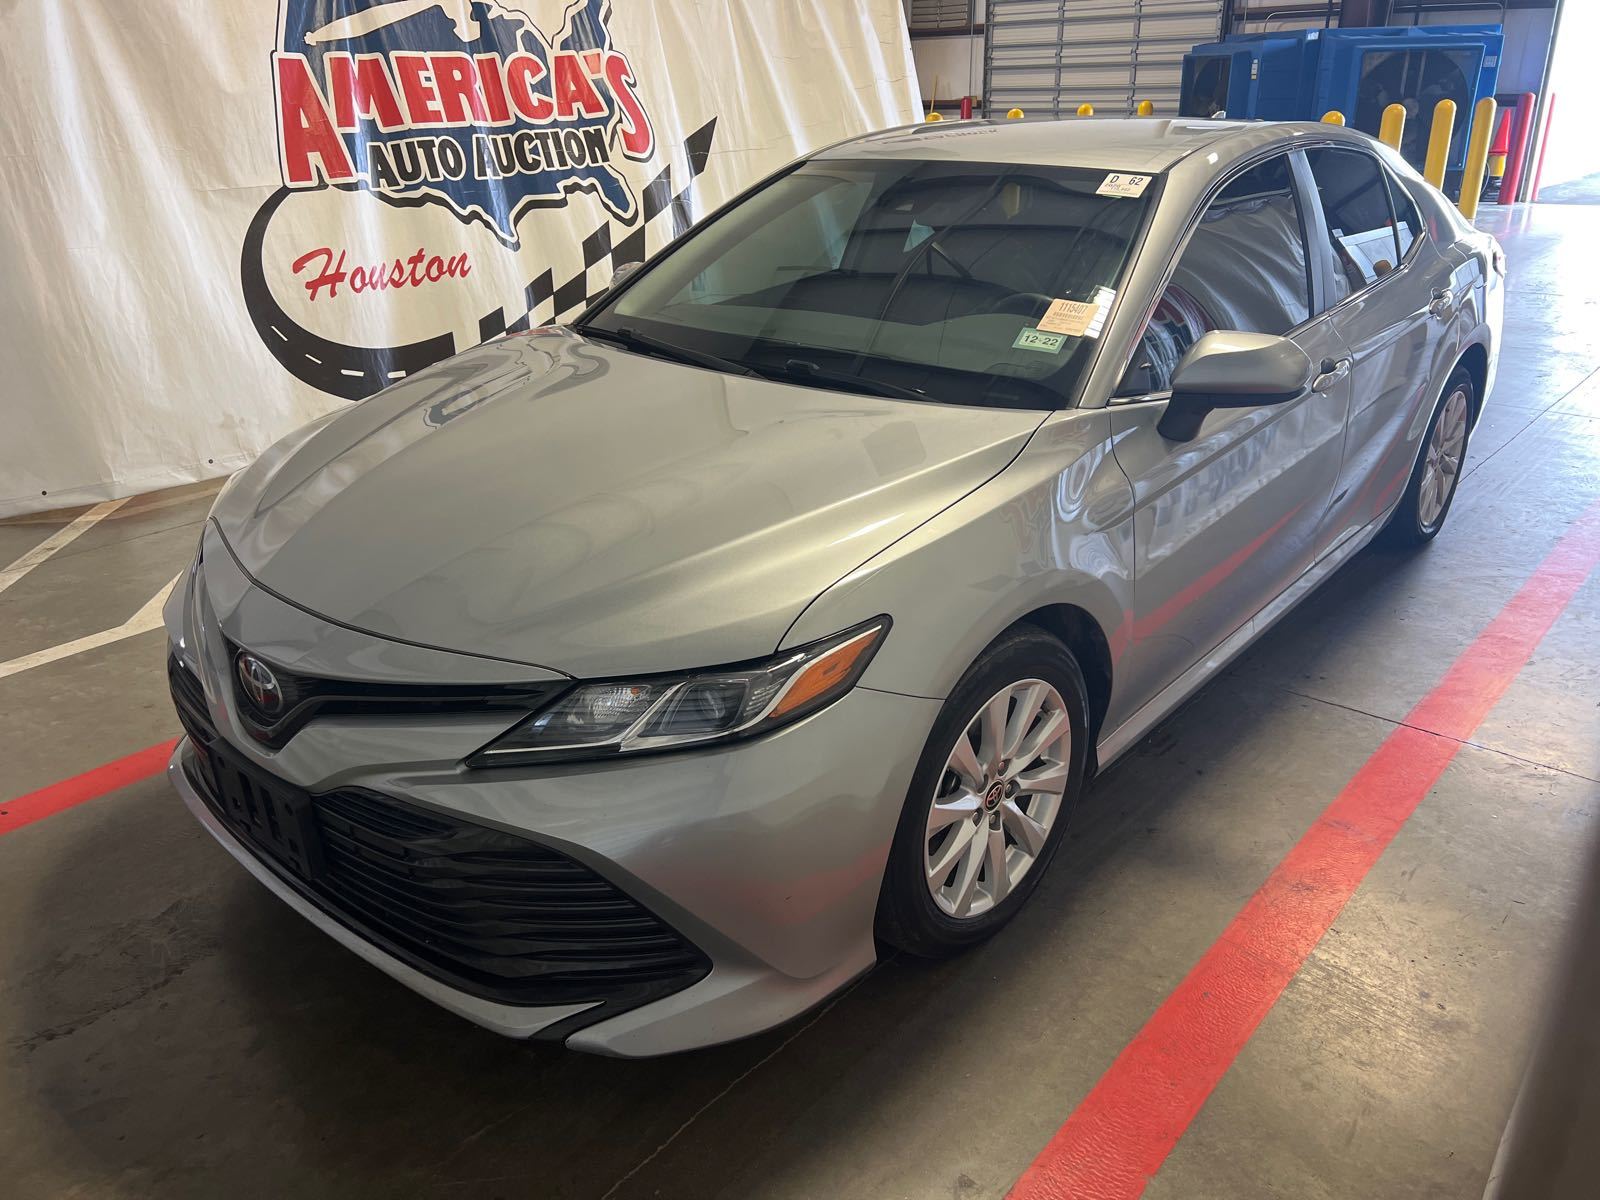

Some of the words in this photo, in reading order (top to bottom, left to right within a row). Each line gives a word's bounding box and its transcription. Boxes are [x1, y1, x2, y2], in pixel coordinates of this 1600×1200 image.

[275, 51, 653, 185] AMERICA'S
[371, 138, 465, 187] AUTO
[475, 127, 611, 178] AUCTION
[1128, 176, 1144, 186] 62
[292, 247, 472, 301] Houston
